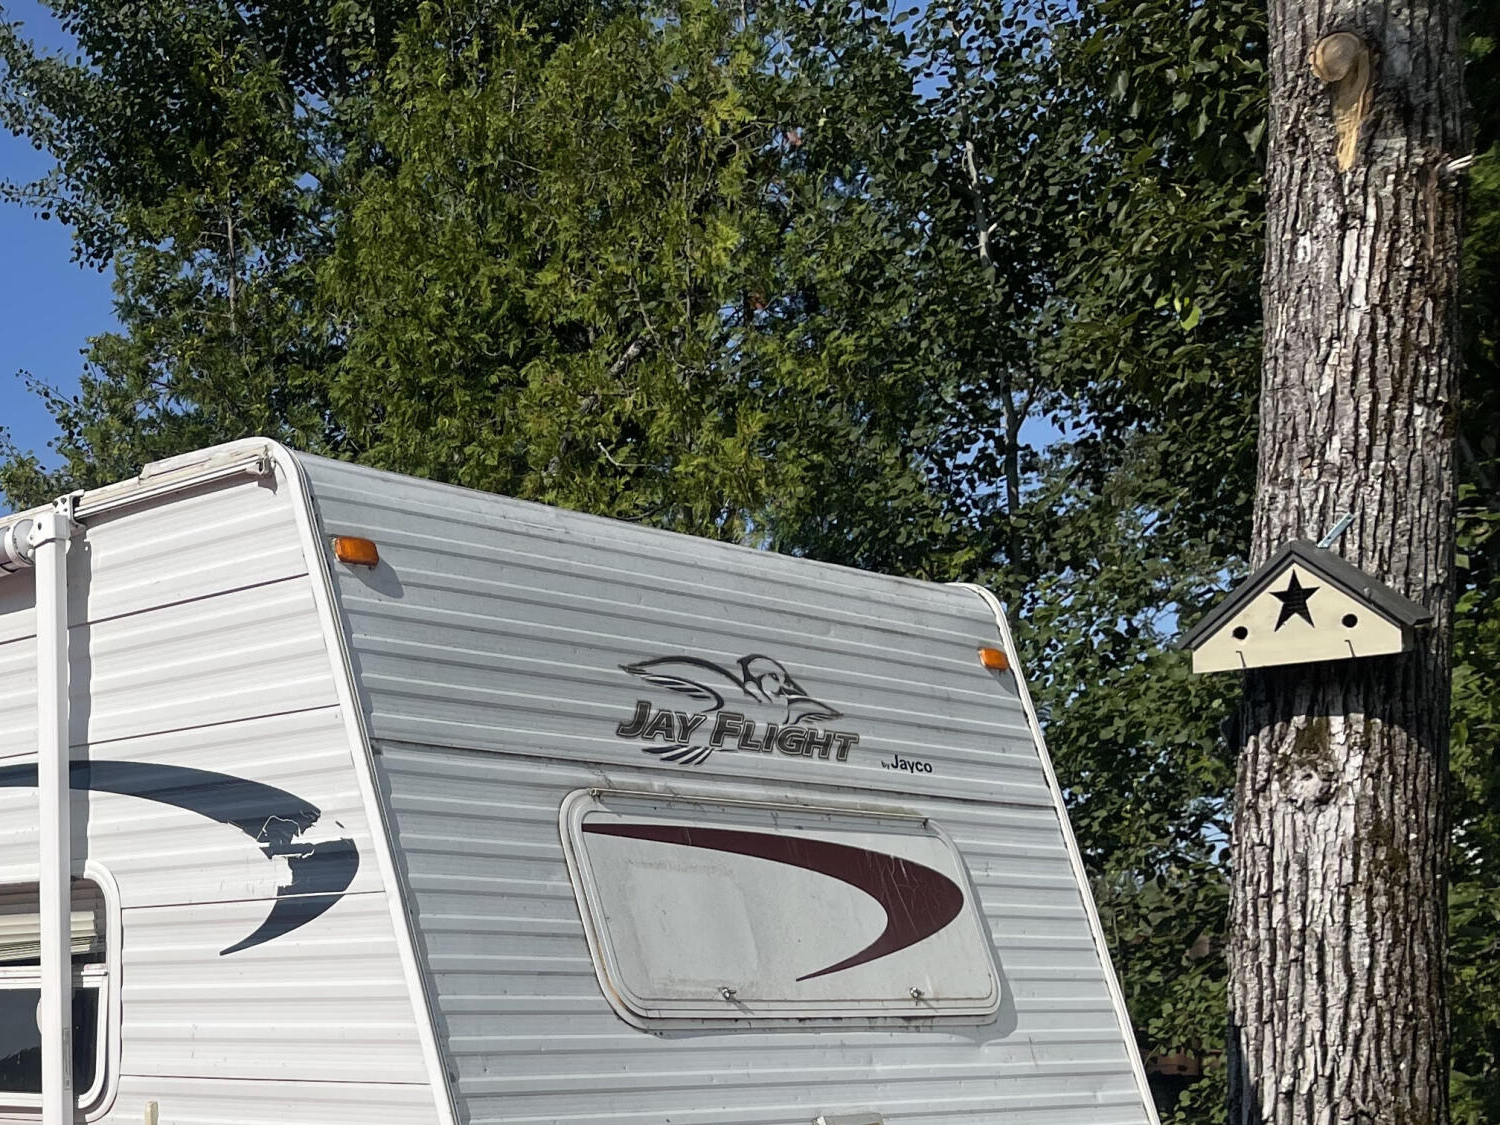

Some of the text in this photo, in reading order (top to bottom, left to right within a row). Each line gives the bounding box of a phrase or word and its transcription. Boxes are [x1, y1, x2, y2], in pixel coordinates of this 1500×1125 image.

[616, 700, 860, 762] JAY FLIGHT
[891, 754, 933, 774] Jayco
